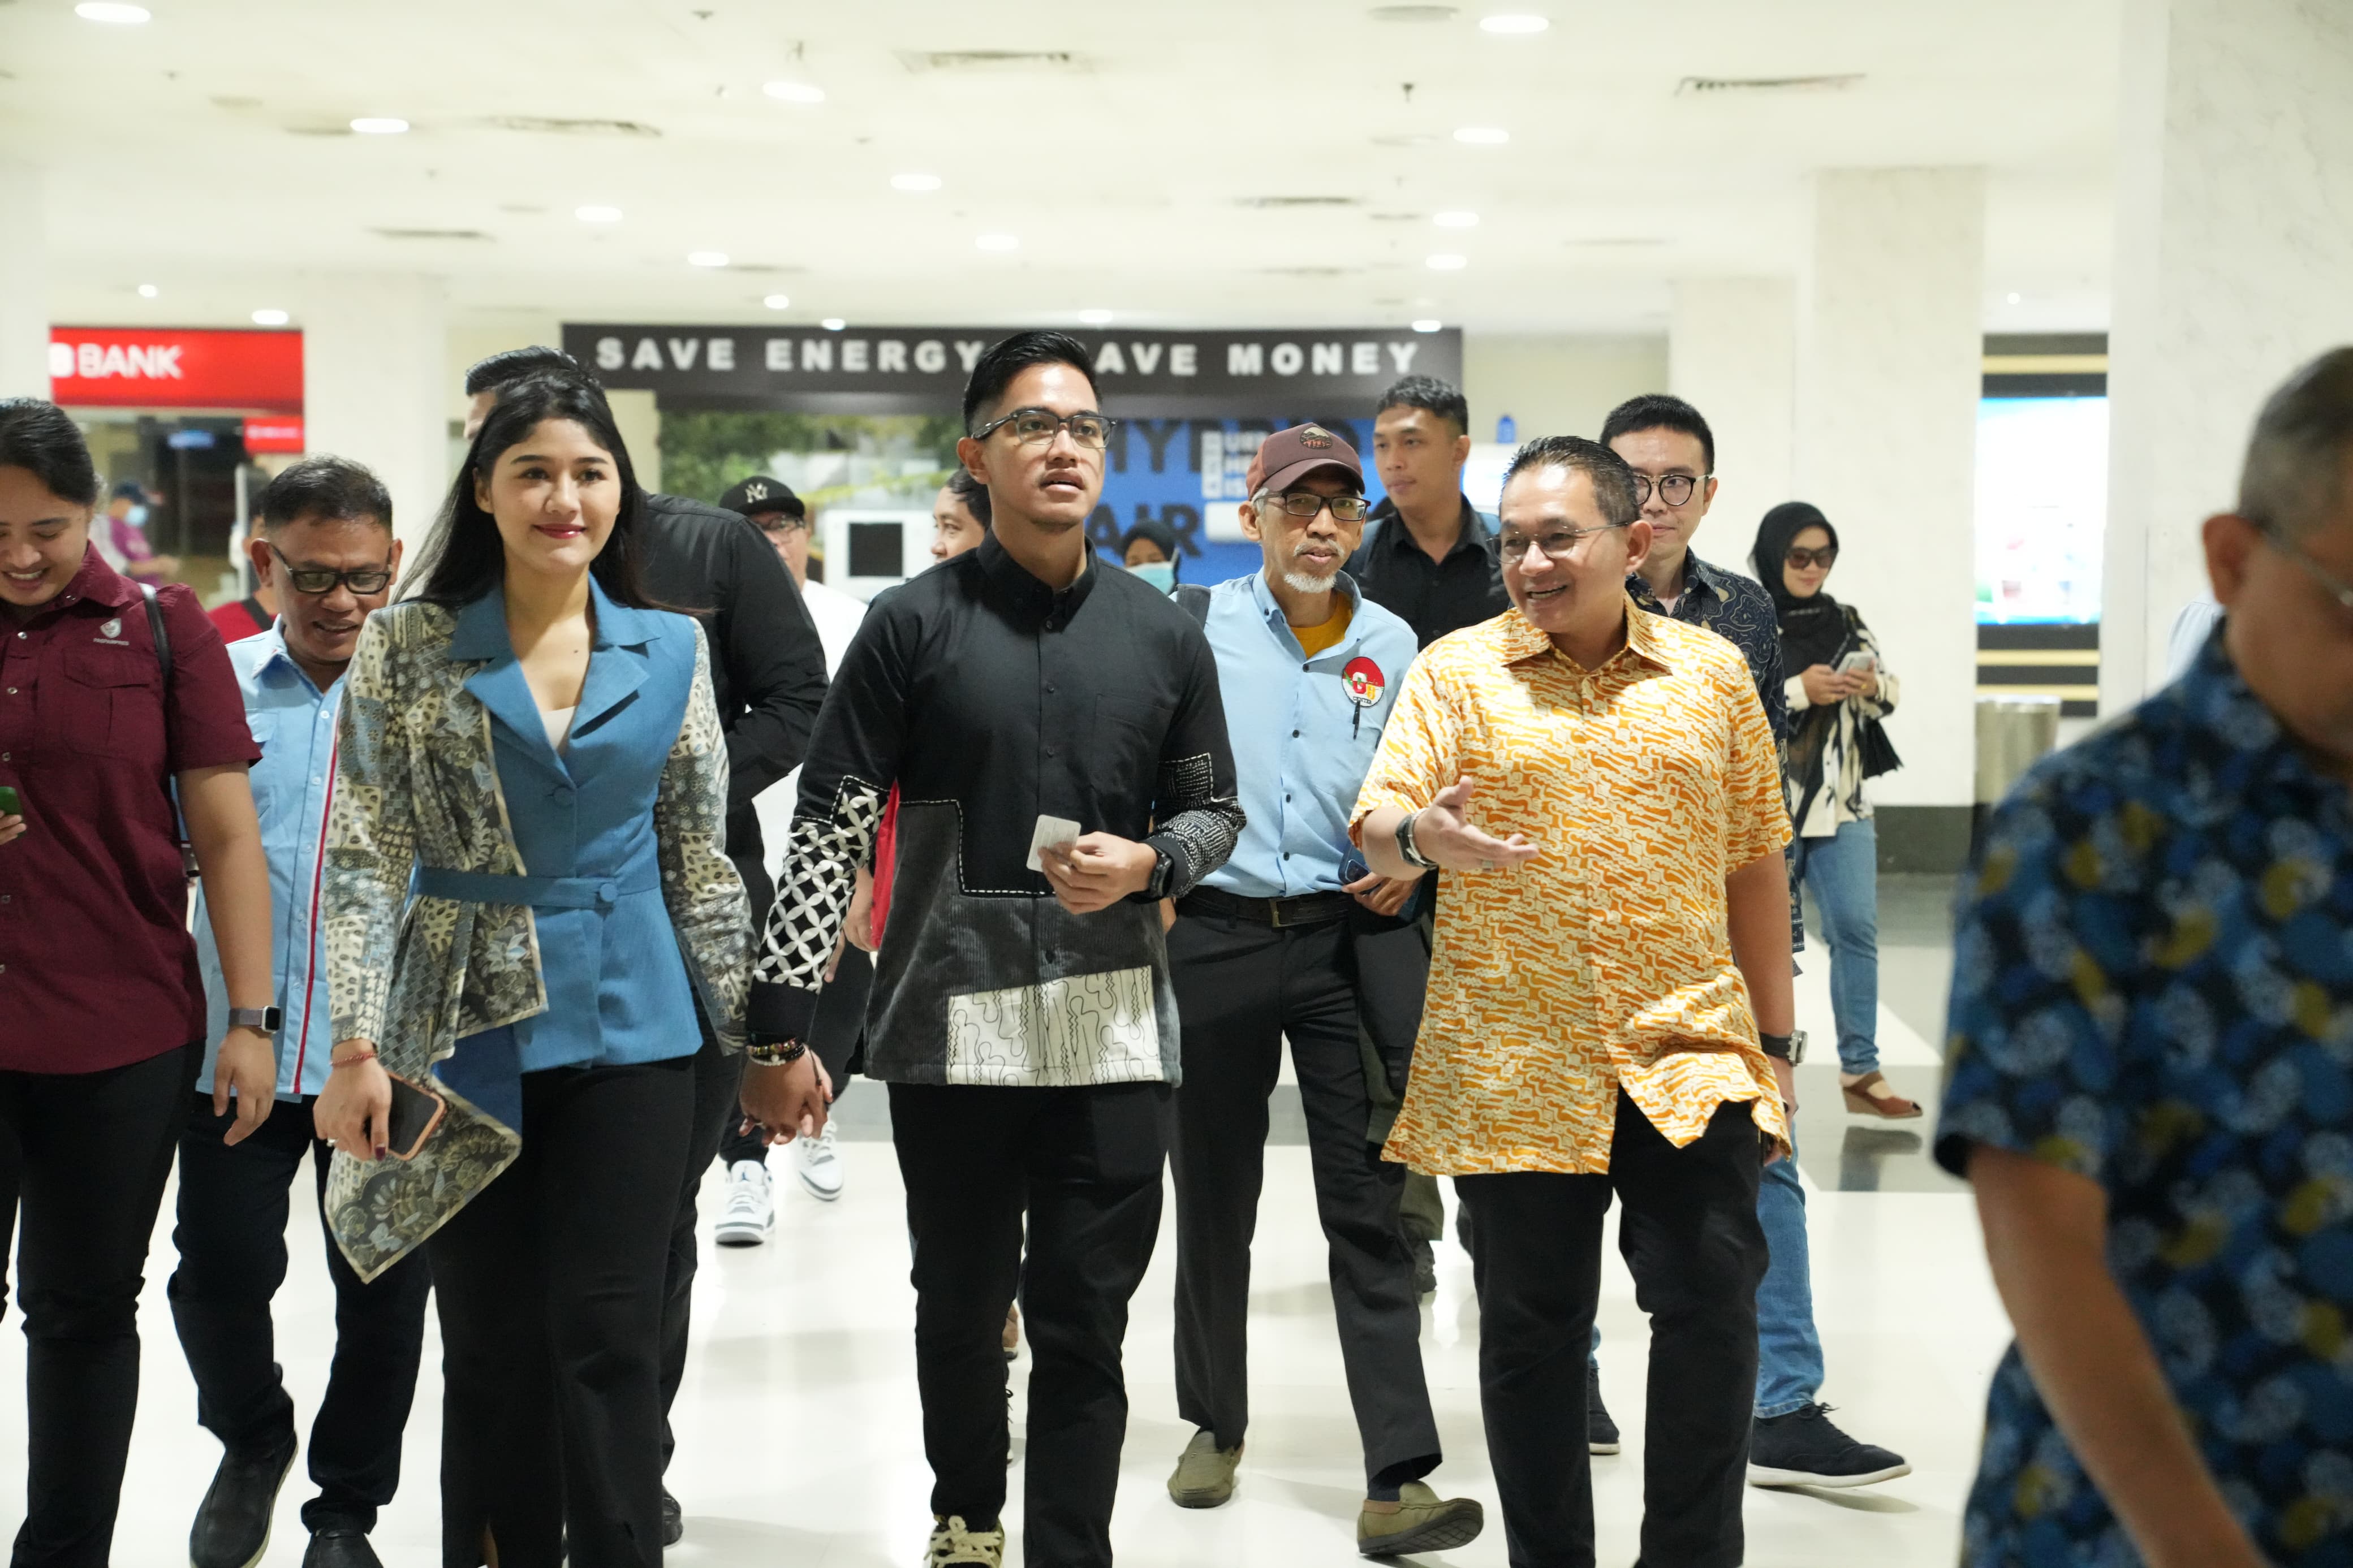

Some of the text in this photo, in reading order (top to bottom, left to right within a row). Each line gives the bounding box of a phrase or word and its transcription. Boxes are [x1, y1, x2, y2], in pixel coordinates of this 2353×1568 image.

[78, 343, 184, 379] BANK
[596, 337, 1418, 375] SAVE ENERGY AVE MONEY
